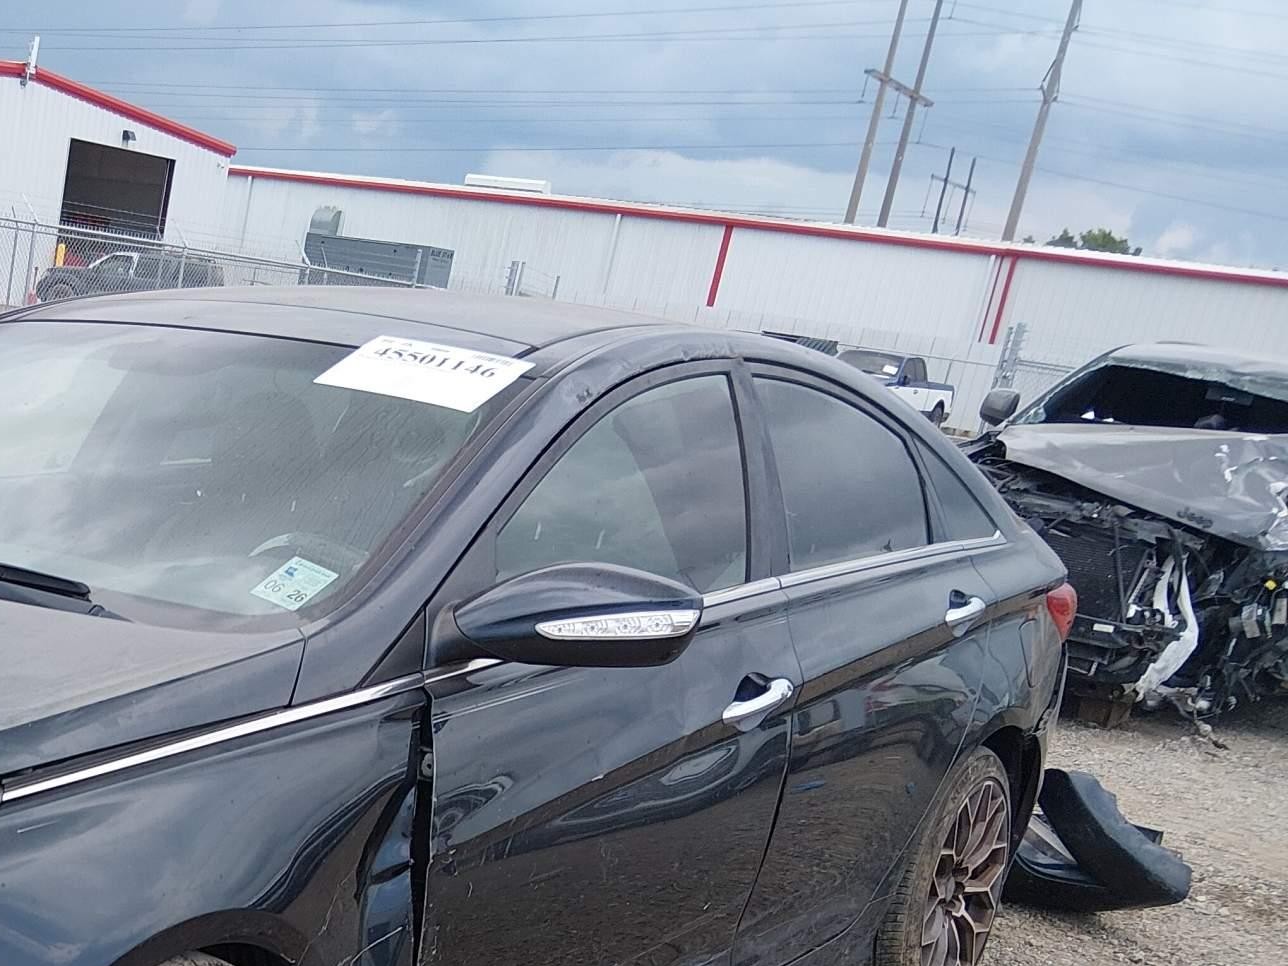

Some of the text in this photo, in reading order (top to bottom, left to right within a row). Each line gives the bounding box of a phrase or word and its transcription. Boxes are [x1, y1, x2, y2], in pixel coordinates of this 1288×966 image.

[374, 347, 496, 378] 45501146
[264, 580, 308, 602] 06 26
